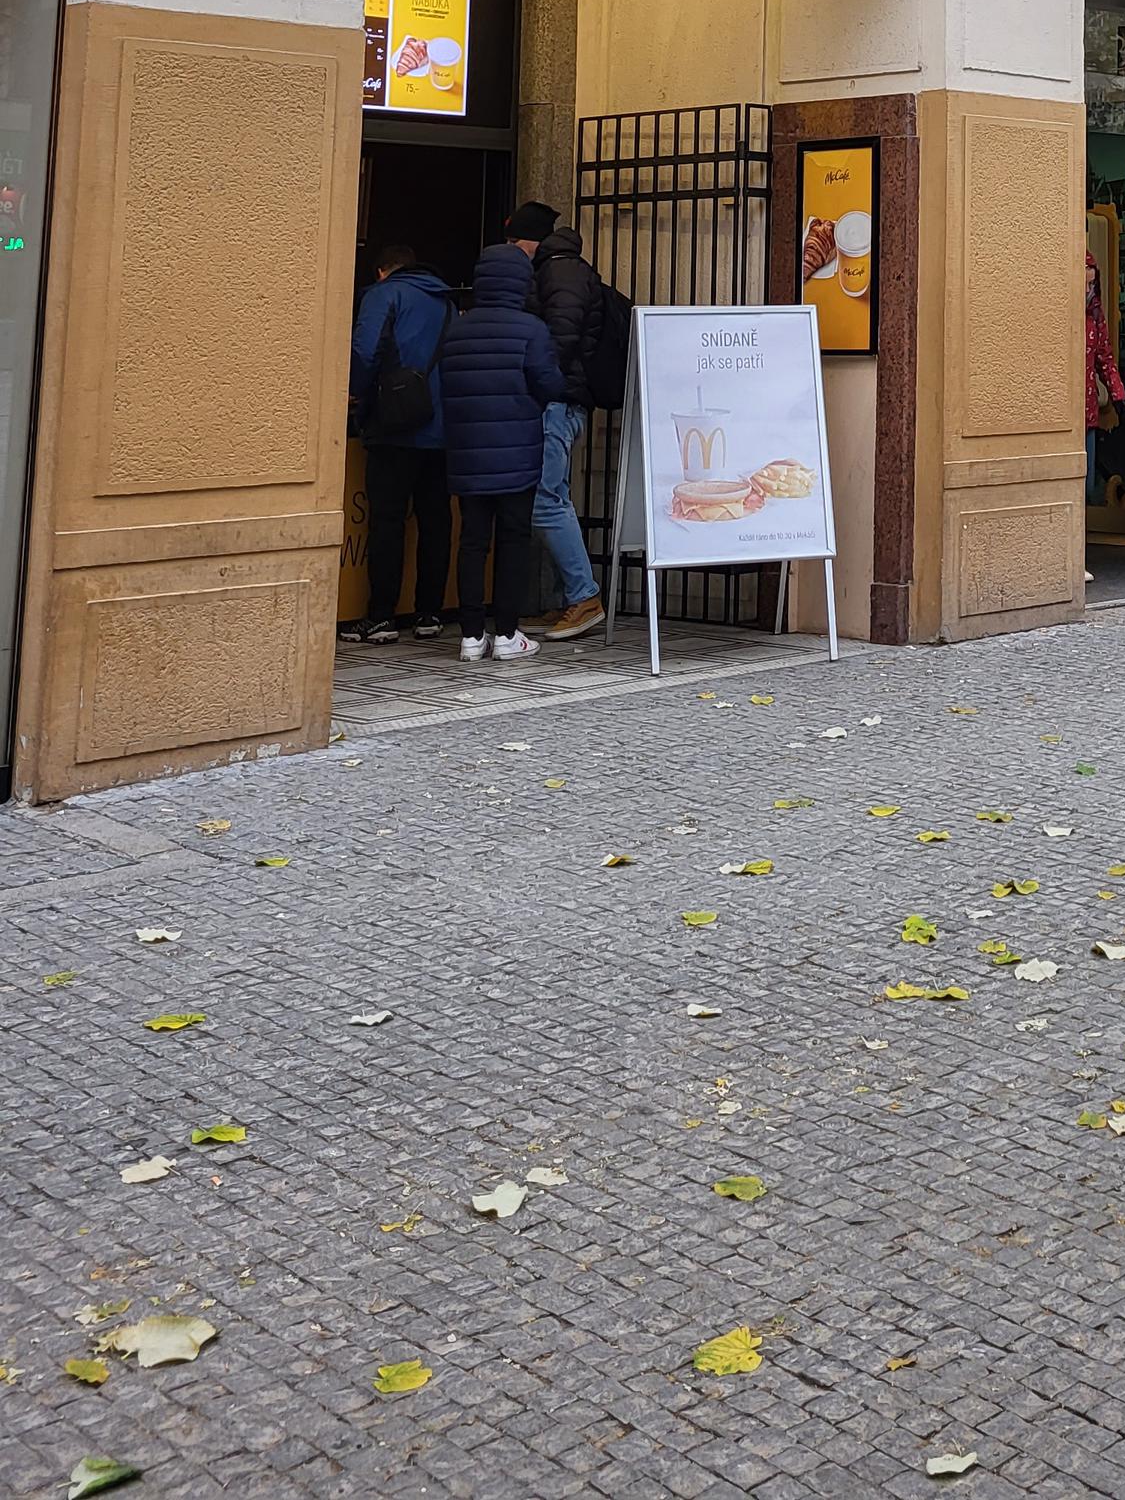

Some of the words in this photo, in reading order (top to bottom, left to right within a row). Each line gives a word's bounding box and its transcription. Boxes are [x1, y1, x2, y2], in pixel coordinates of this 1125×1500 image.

[824, 168, 851, 186] McCafé
[701, 329, 759, 348] SNÍDANĚ
[697, 355, 716, 373] jak
[718, 357, 733, 369] se
[735, 353, 765, 372] patří
